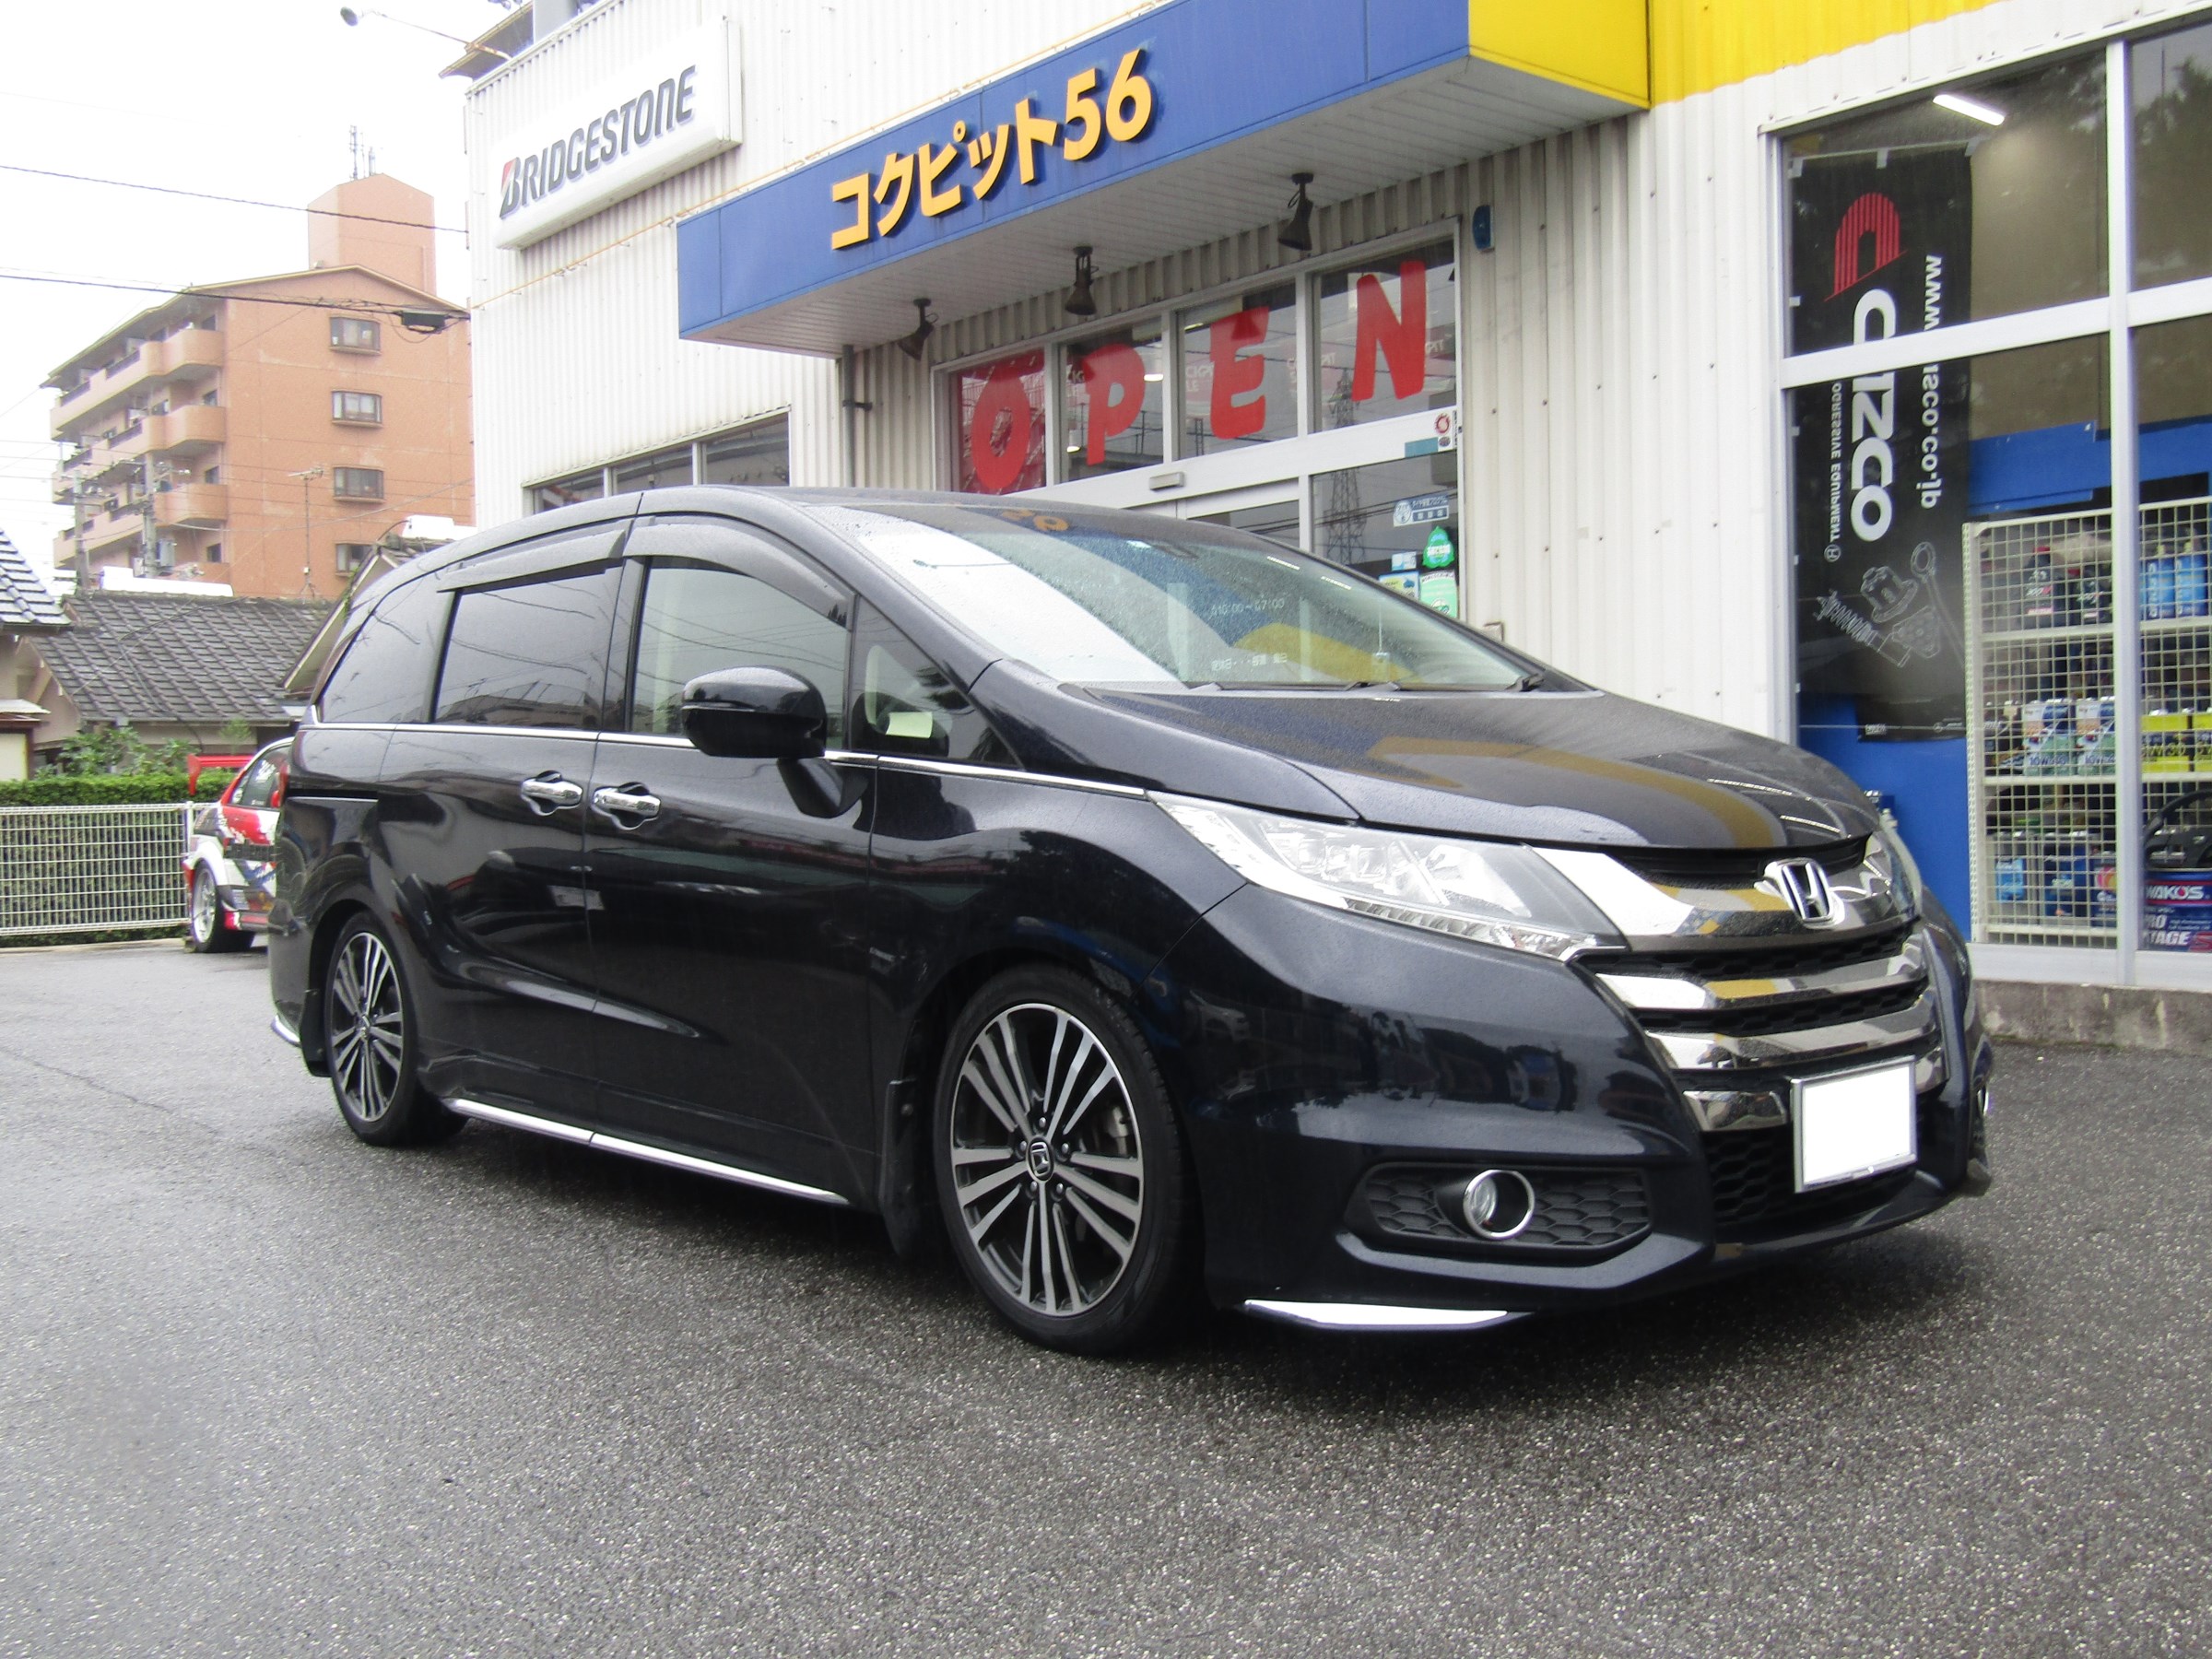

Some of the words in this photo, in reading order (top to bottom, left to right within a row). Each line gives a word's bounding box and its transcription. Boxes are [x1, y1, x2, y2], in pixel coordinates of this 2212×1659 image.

[500, 65, 696, 220] BRIDGESTONE
[831, 49, 1152, 251] コクピット56
[971, 261, 1427, 494] OPEN
